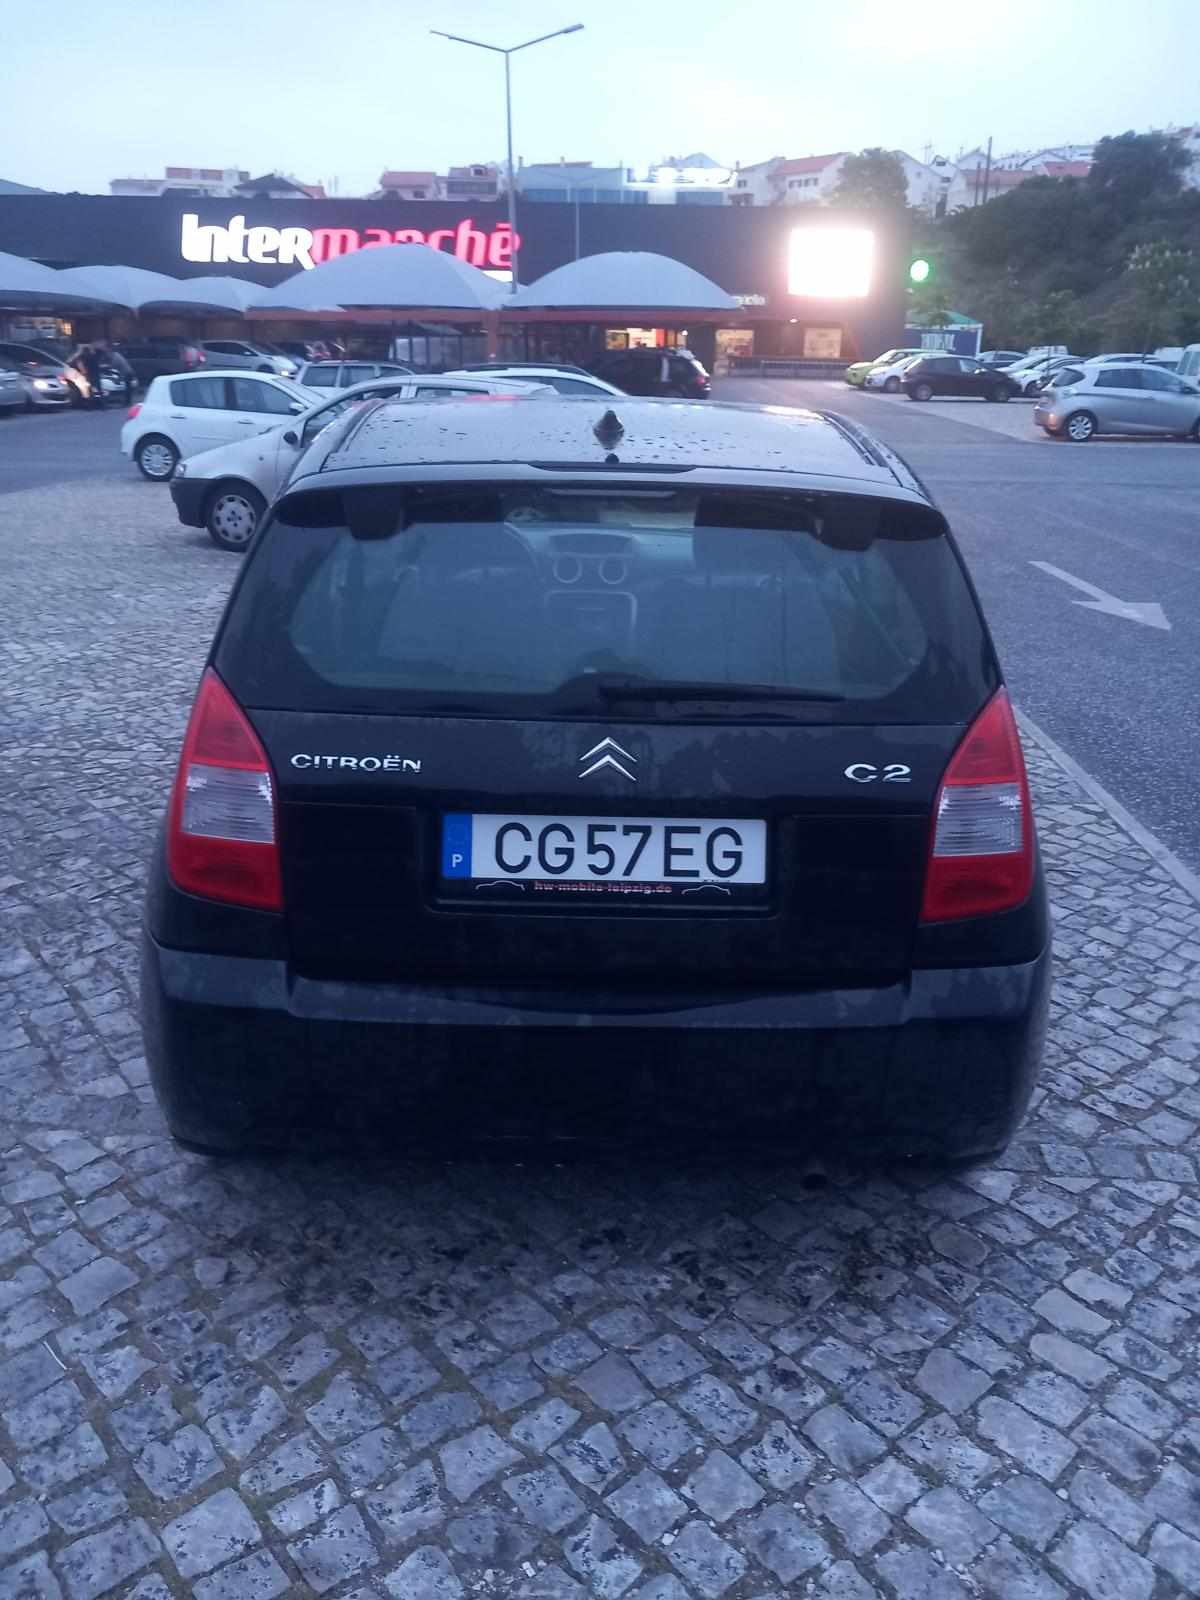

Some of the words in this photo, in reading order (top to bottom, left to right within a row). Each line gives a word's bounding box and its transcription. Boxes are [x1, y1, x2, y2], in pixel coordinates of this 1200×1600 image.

[290, 753, 422, 773] CITROËN
[843, 763, 912, 783] C2
[451, 853, 463, 868] P
[495, 822, 743, 879] CG57EG
